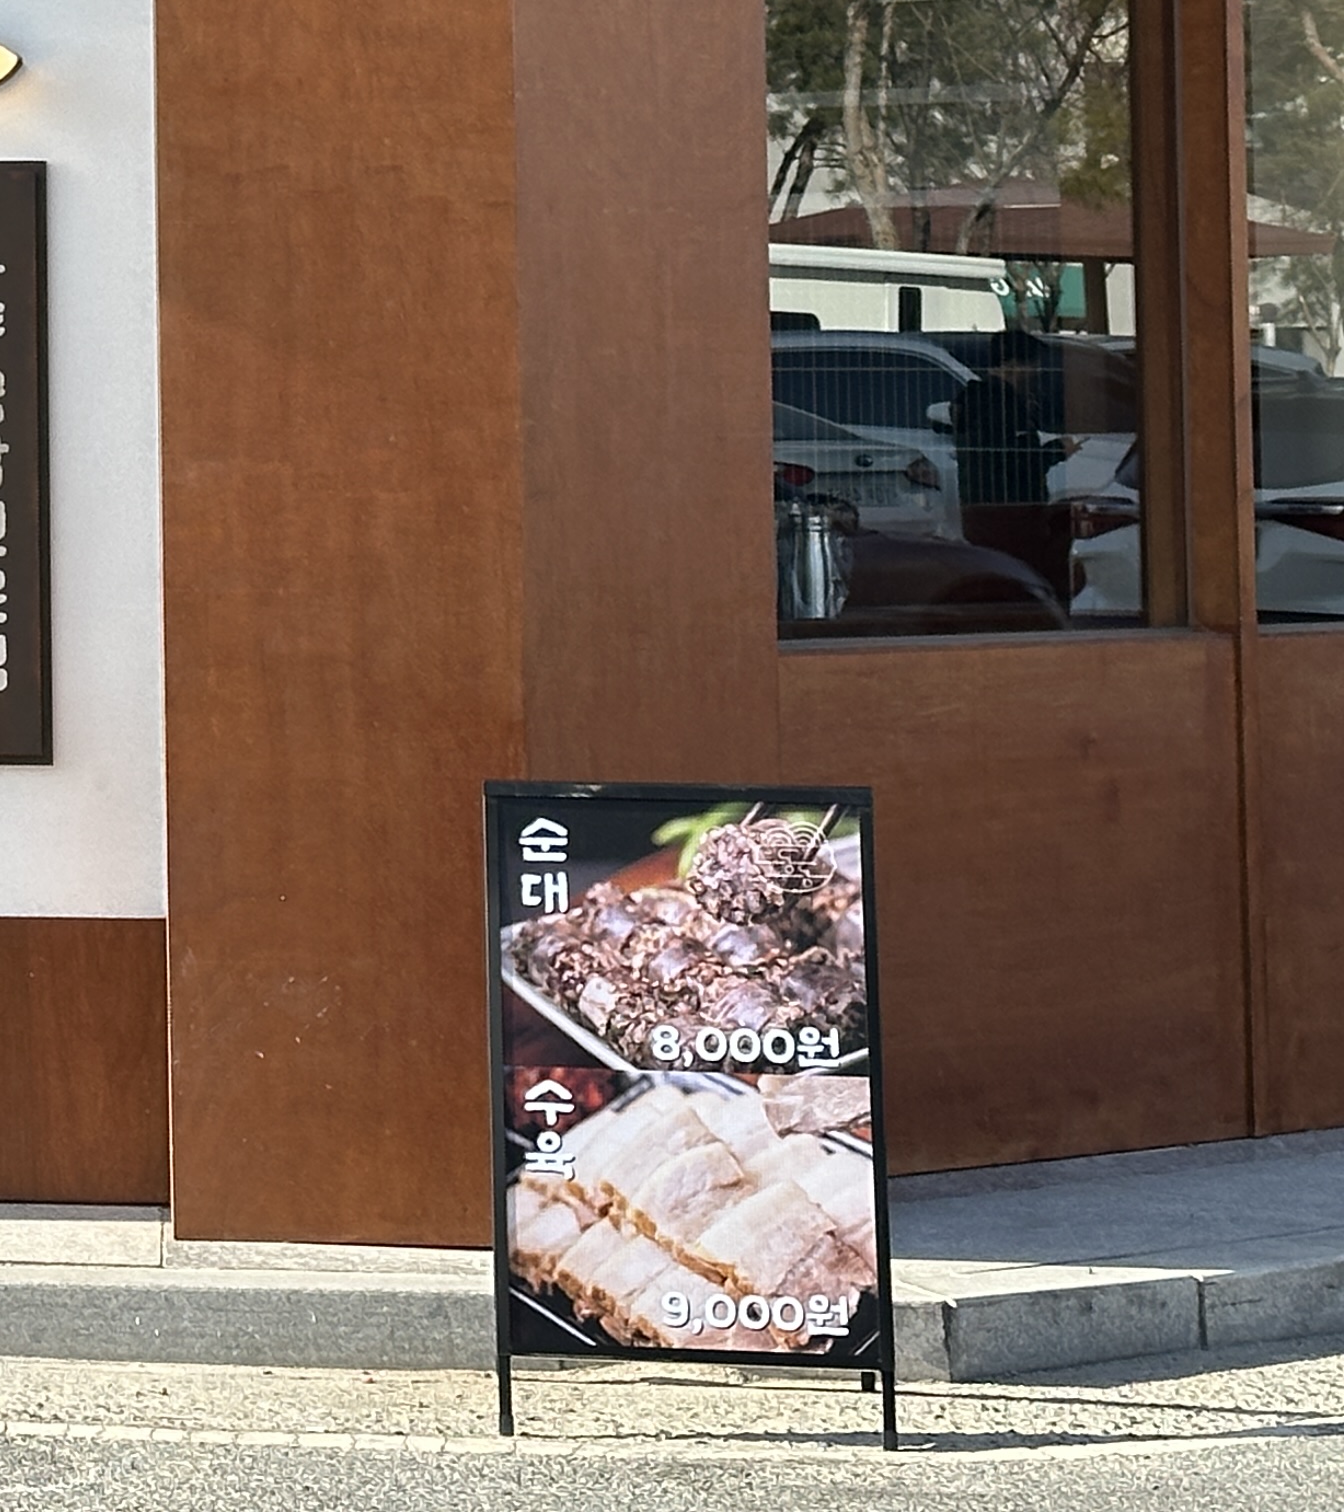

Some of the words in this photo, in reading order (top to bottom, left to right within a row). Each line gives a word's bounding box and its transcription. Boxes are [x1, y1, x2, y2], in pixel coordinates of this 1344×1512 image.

[519, 817, 571, 915] 순대
[651, 1026, 841, 1070] 8,000원
[524, 1078, 576, 1182] 수육
[660, 1292, 851, 1337] 9,000원
